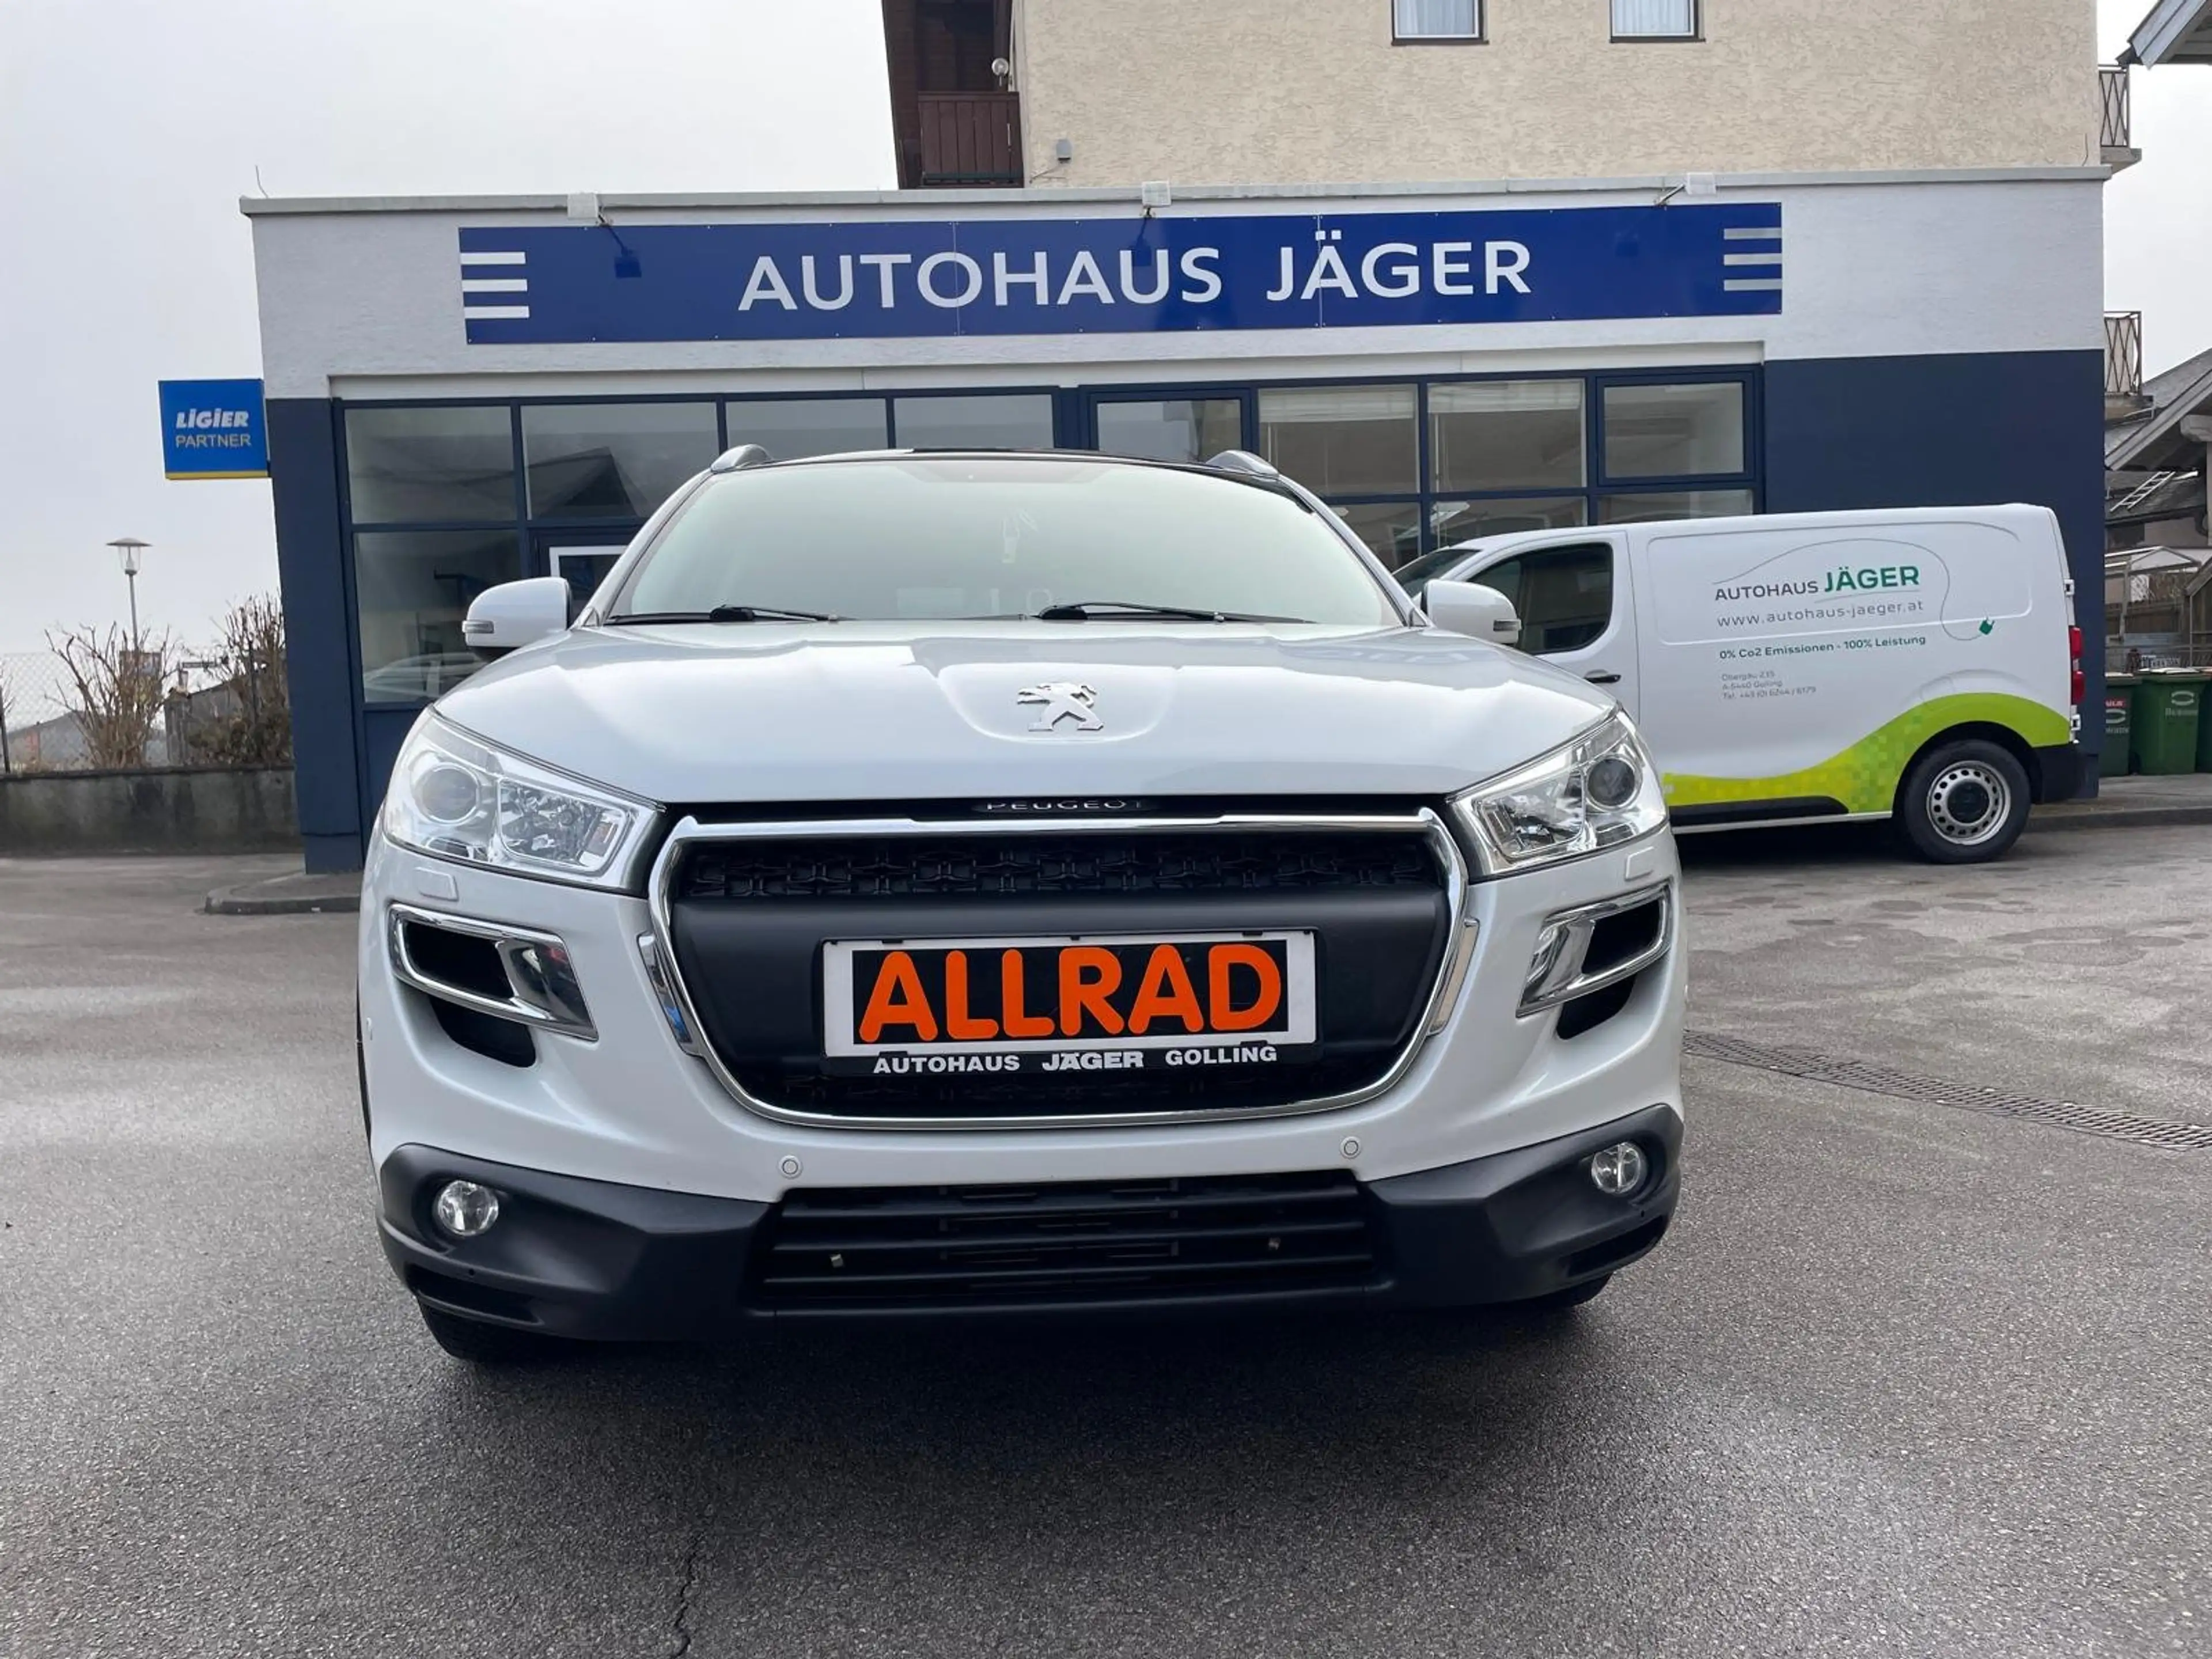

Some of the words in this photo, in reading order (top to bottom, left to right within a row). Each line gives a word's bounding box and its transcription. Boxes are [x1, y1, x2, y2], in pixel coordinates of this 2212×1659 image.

[738, 247, 1221, 312] AUTOHAUS
[1266, 230, 1532, 302] JÄGER
[176, 434, 252, 448] PARTNER
[1715, 581, 1819, 601] AUTOHAUS
[1824, 566, 1920, 593] JÄGER
[1717, 601, 1923, 627] www.autohaus-jaeger.at
[1719, 650, 1736, 660] 0%
[1739, 647, 1763, 658] Co2
[1765, 642, 1834, 656] Emissionen
[1844, 639, 1873, 650] 100%
[1876, 637, 1926, 647] Leistung
[858, 944, 1282, 1043] ALLRAD
[873, 1055, 1020, 1074] AUTOHAUS
[1042, 1051, 1144, 1072] JÄGER
[1165, 1046, 1278, 1066] GOLLING
